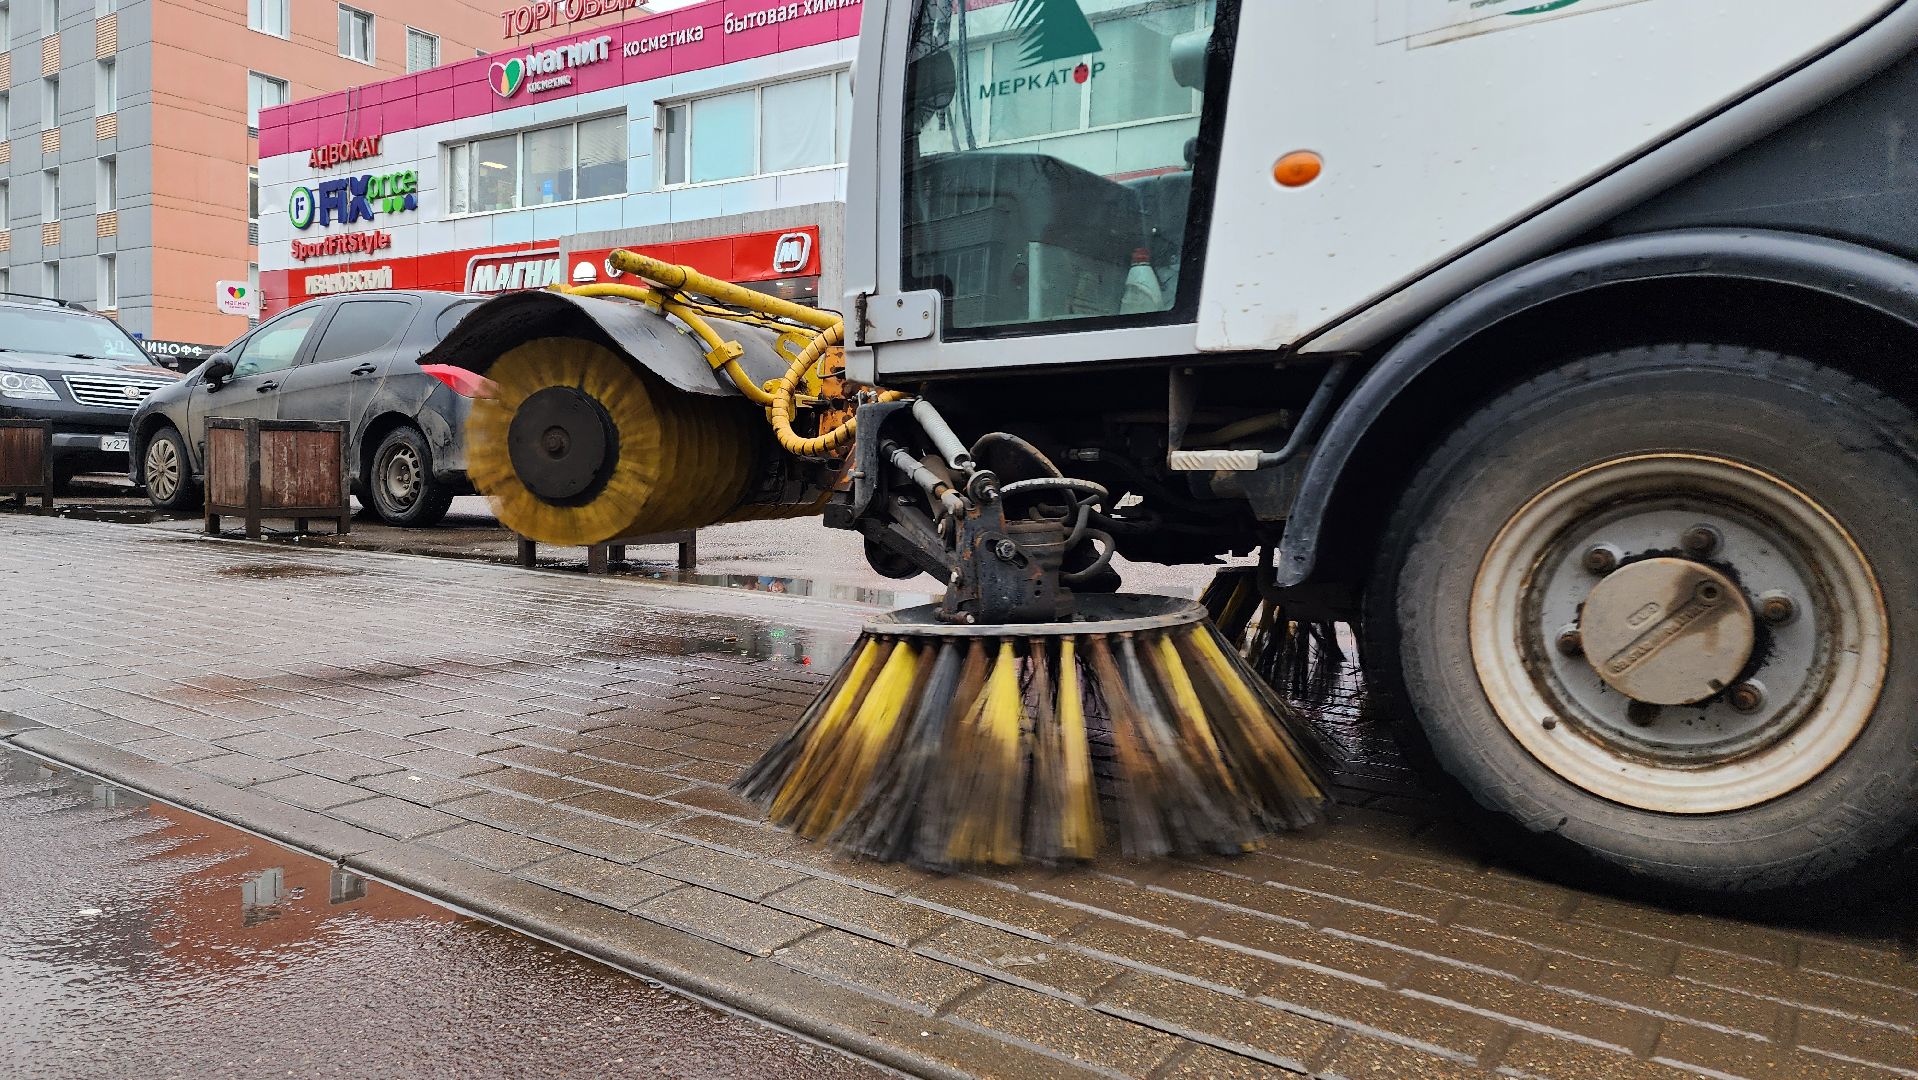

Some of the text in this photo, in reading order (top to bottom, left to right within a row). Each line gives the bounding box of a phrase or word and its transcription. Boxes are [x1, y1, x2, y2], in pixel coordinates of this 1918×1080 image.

[501, 0, 648, 38] ТОРГОВ
[724, 2, 798, 34] бытовая
[623, 25, 704, 58] косметика
[308, 135, 382, 169] АДВОКАТ
[291, 230, 391, 261] SportFitStyle
[305, 265, 392, 295] ИВАНОВСКИЙ
